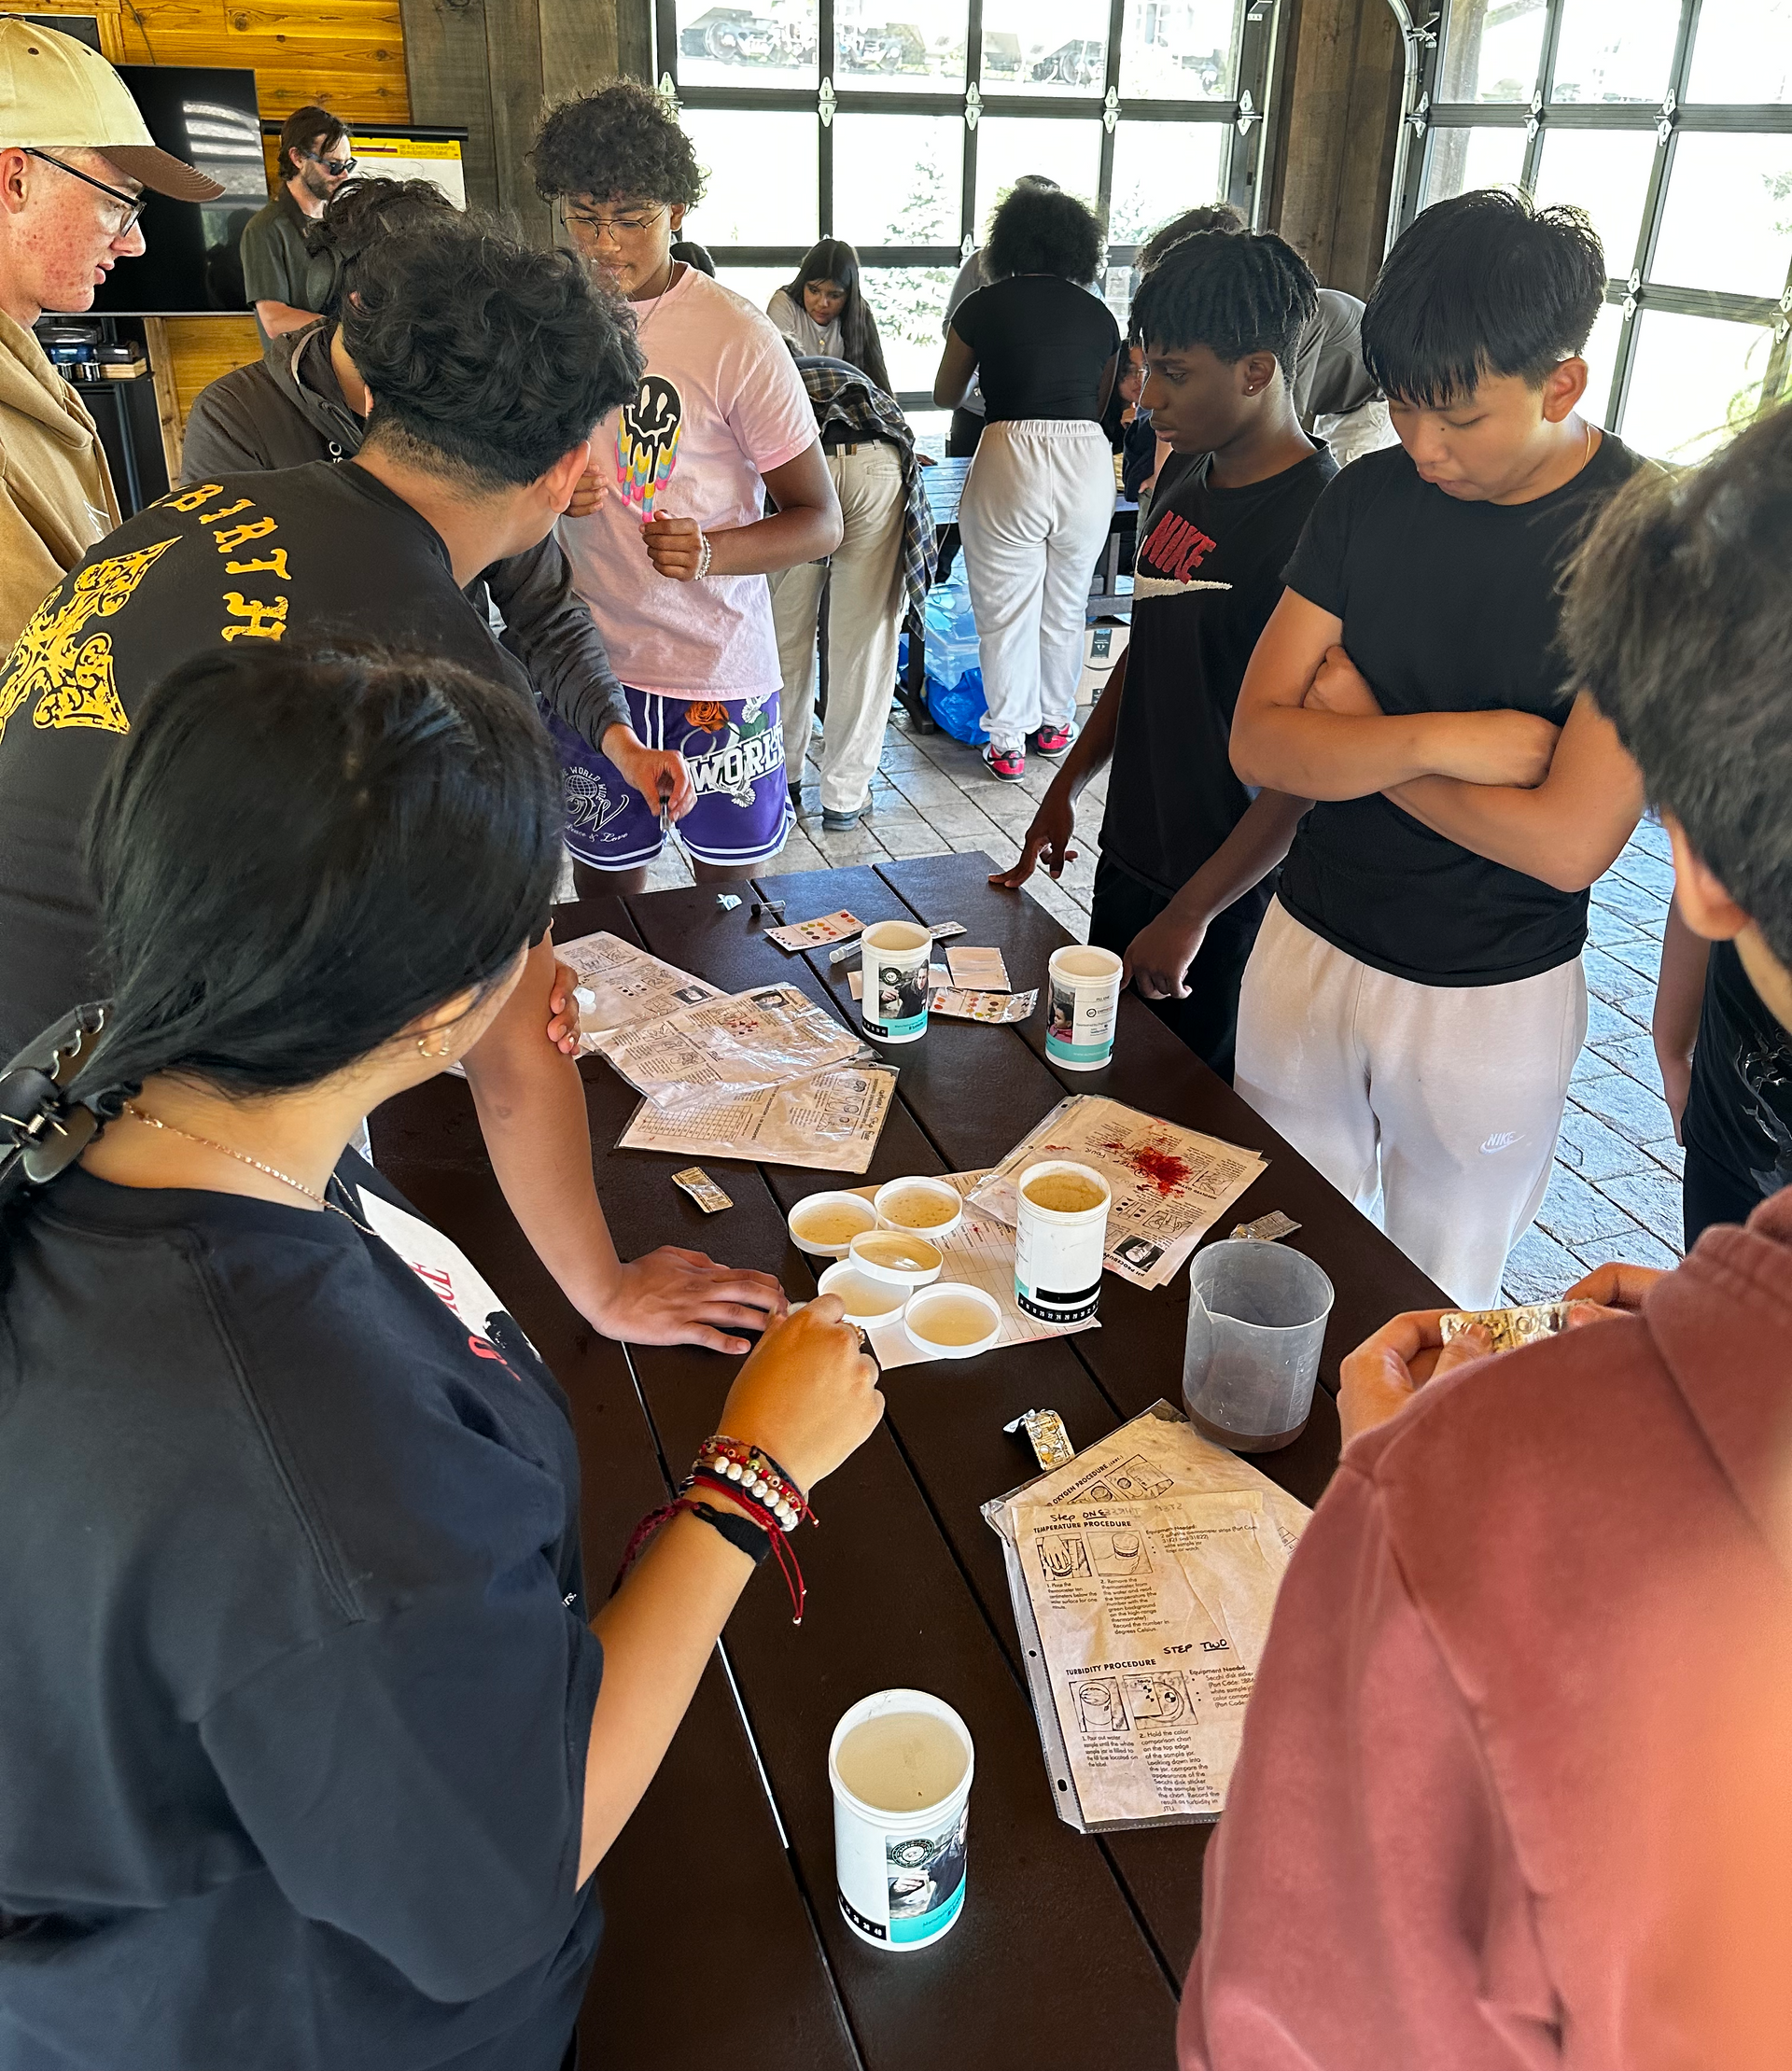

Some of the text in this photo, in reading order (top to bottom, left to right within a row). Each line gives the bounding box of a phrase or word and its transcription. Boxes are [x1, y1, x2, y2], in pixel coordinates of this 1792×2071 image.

[1141, 510, 1217, 585] NIKE
[569, 766, 601, 782] WORLD
[600, 832, 628, 842] Love
[1487, 1131, 1516, 1147] NIKE
[1085, 1147, 1106, 1158] FOUR
[1052, 1485, 1077, 1505] OXYGEN
[1075, 1463, 1109, 1487] PROCEDURE
[1050, 1509, 1107, 1522] Step ONE
[1033, 1522, 1082, 1533] TEMPERATURE
[1163, 1639, 1230, 1655] STEP TWO
[1066, 1658, 1156, 1676] TURBIDITY PROCEDURE
